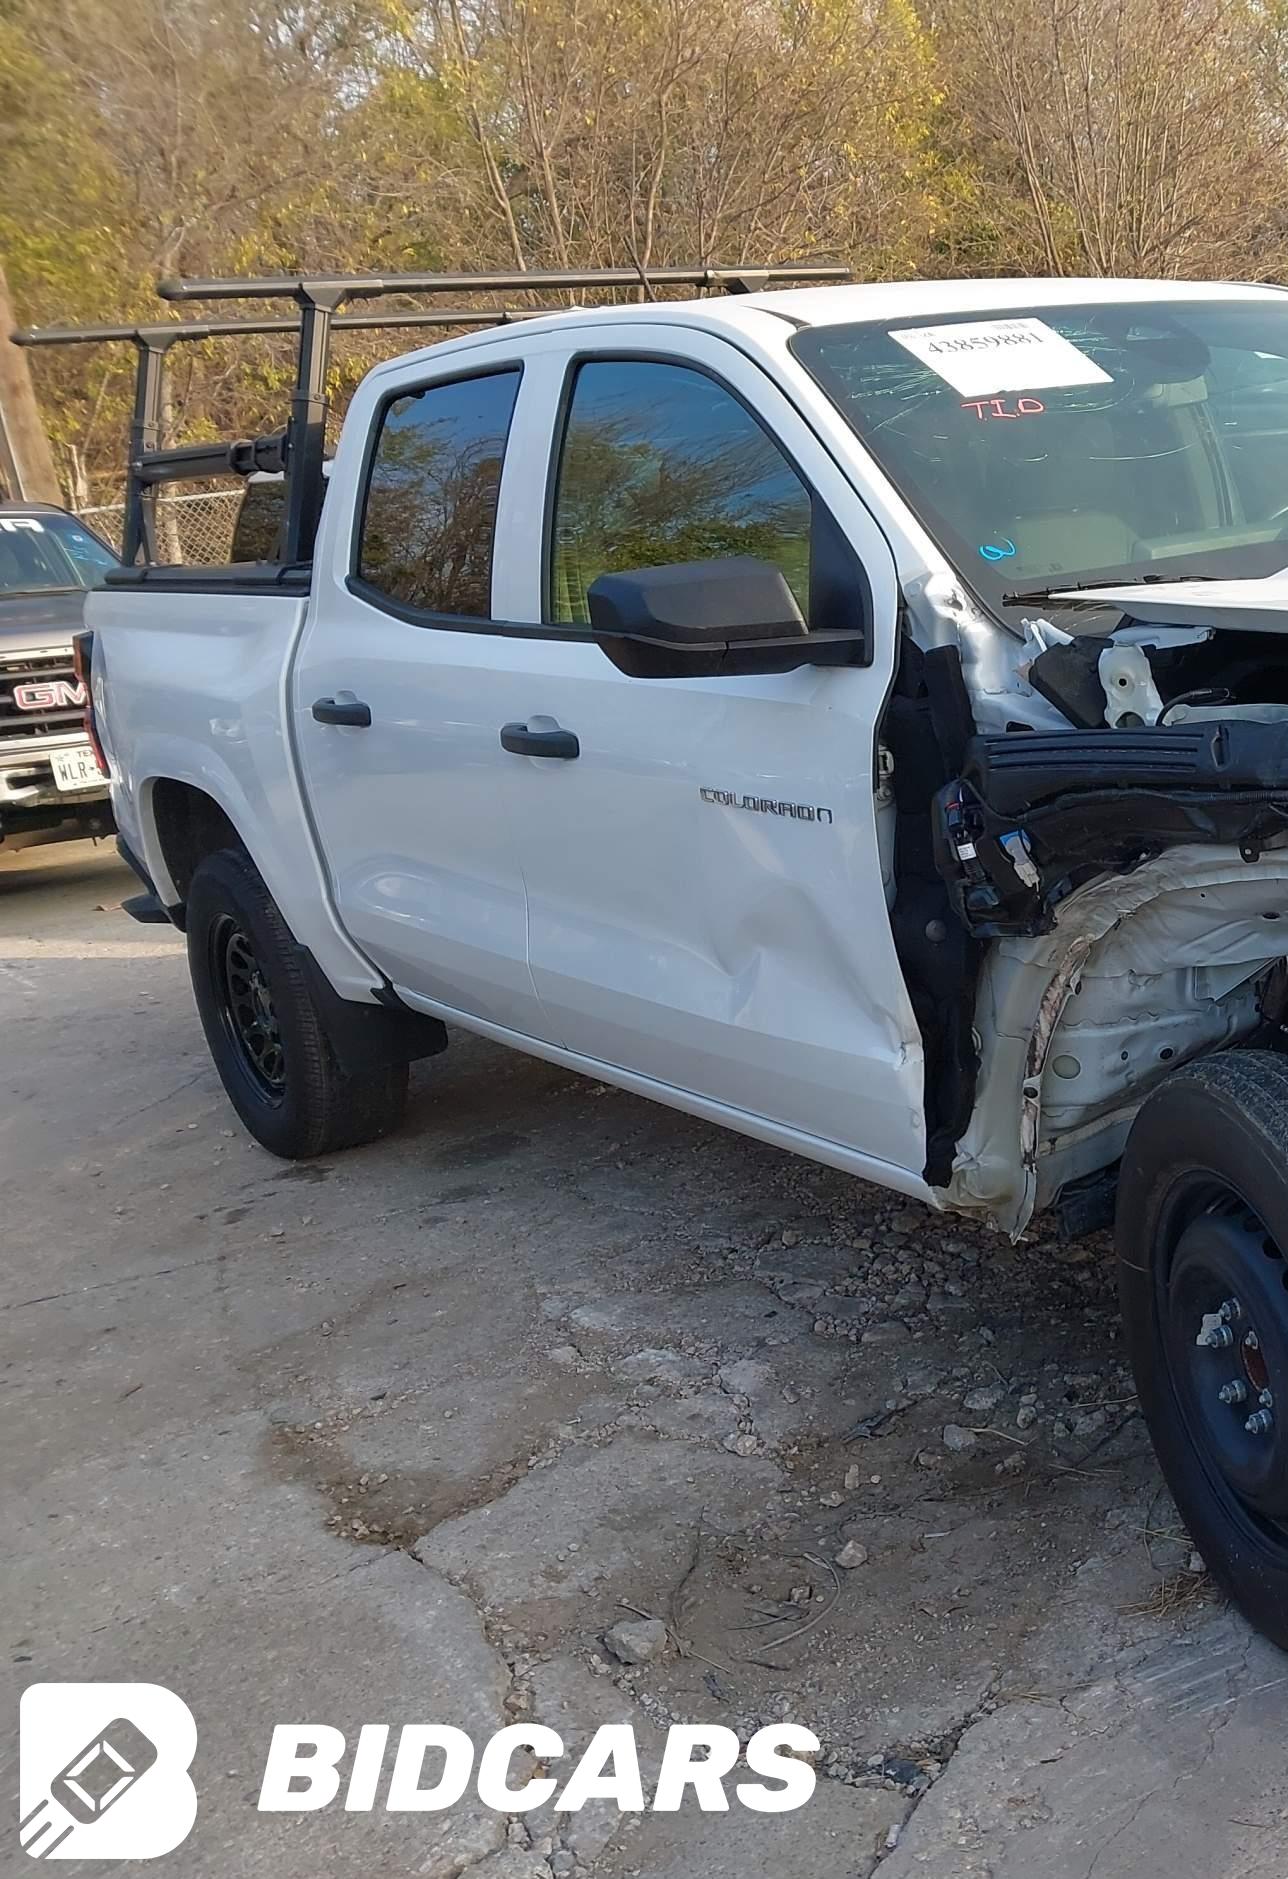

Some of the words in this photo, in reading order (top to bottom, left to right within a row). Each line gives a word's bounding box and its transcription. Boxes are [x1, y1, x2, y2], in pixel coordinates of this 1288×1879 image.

[927, 331, 1044, 355] 43859881
[14, 681, 88, 709] GM
[699, 787, 833, 824] COLORADO
